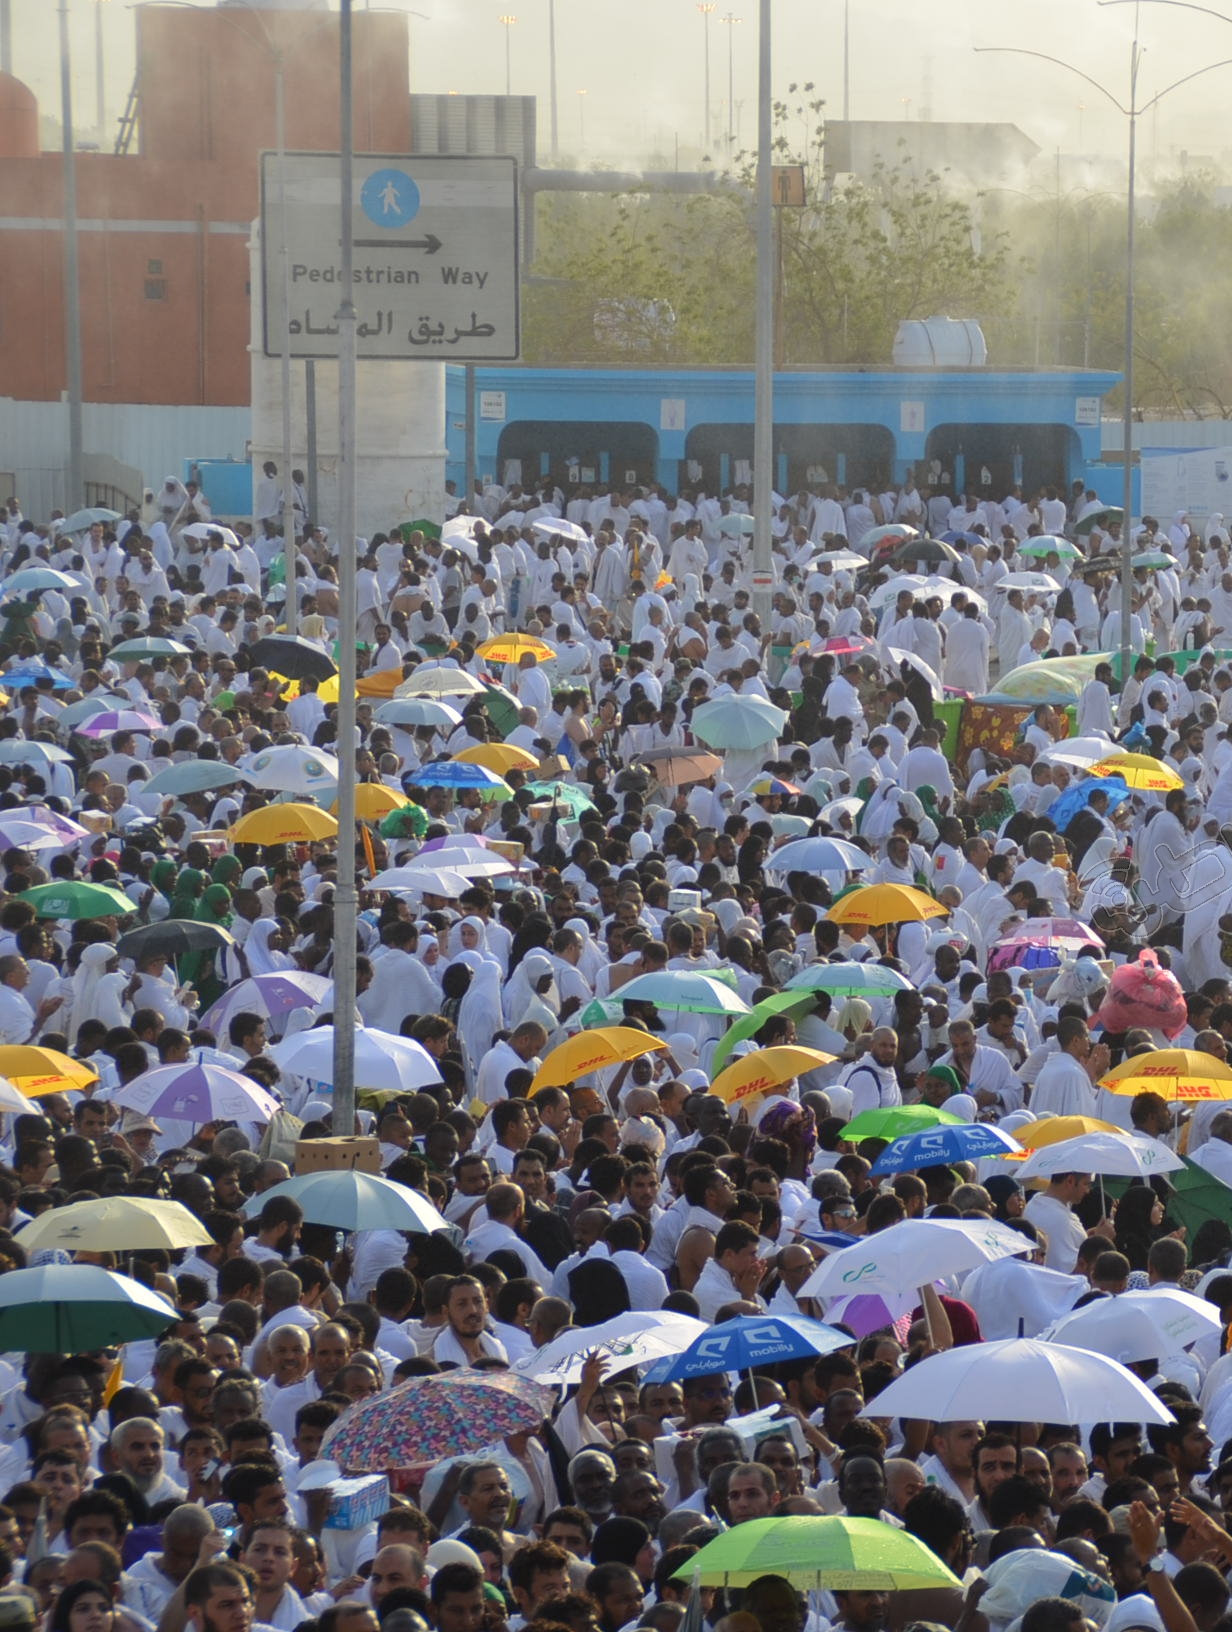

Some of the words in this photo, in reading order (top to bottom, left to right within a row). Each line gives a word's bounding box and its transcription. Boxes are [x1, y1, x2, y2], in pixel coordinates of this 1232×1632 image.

[441, 266, 488, 289] Way
[408, 311, 496, 345] طريق
[577, 1056, 607, 1070] DHL
[1143, 1066, 1179, 1076] DHL
[735, 1077, 770, 1098] DHL
[914, 1149, 950, 1162] mobily
[750, 1344, 794, 1358] mobily
[685, 1359, 726, 1373] موبايلي
